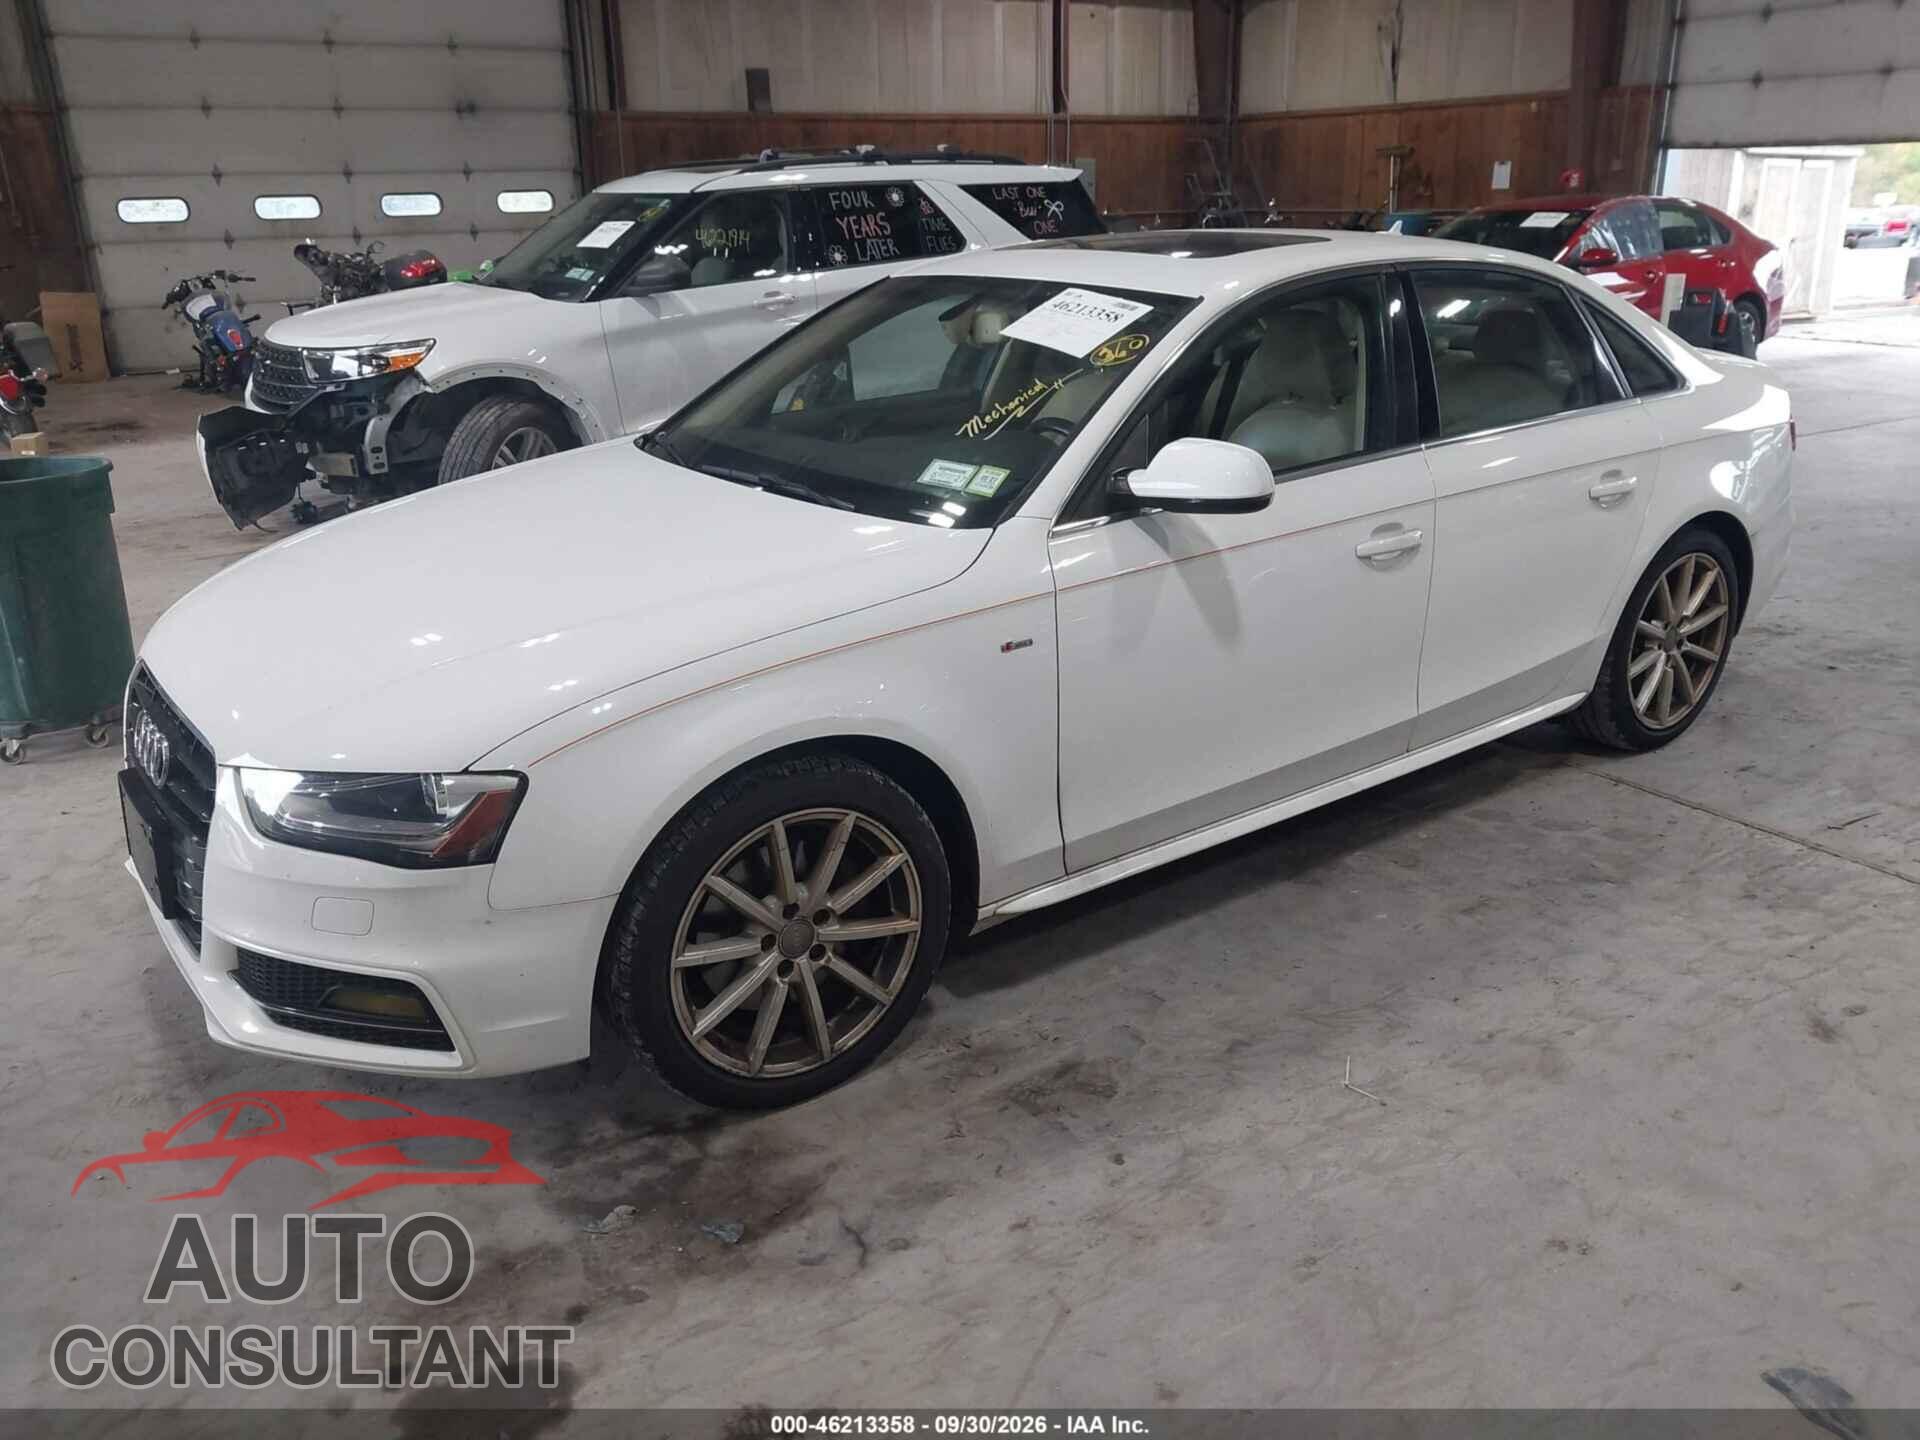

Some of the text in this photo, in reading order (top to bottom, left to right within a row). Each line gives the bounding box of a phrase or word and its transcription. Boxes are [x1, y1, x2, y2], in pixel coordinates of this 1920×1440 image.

[828, 190, 875, 211] FOUR
[992, 185, 1047, 200] LAST ONE
[835, 211, 891, 240] YEARS
[854, 238, 900, 262] LATER
[954, 378, 1048, 437] Mechanical
